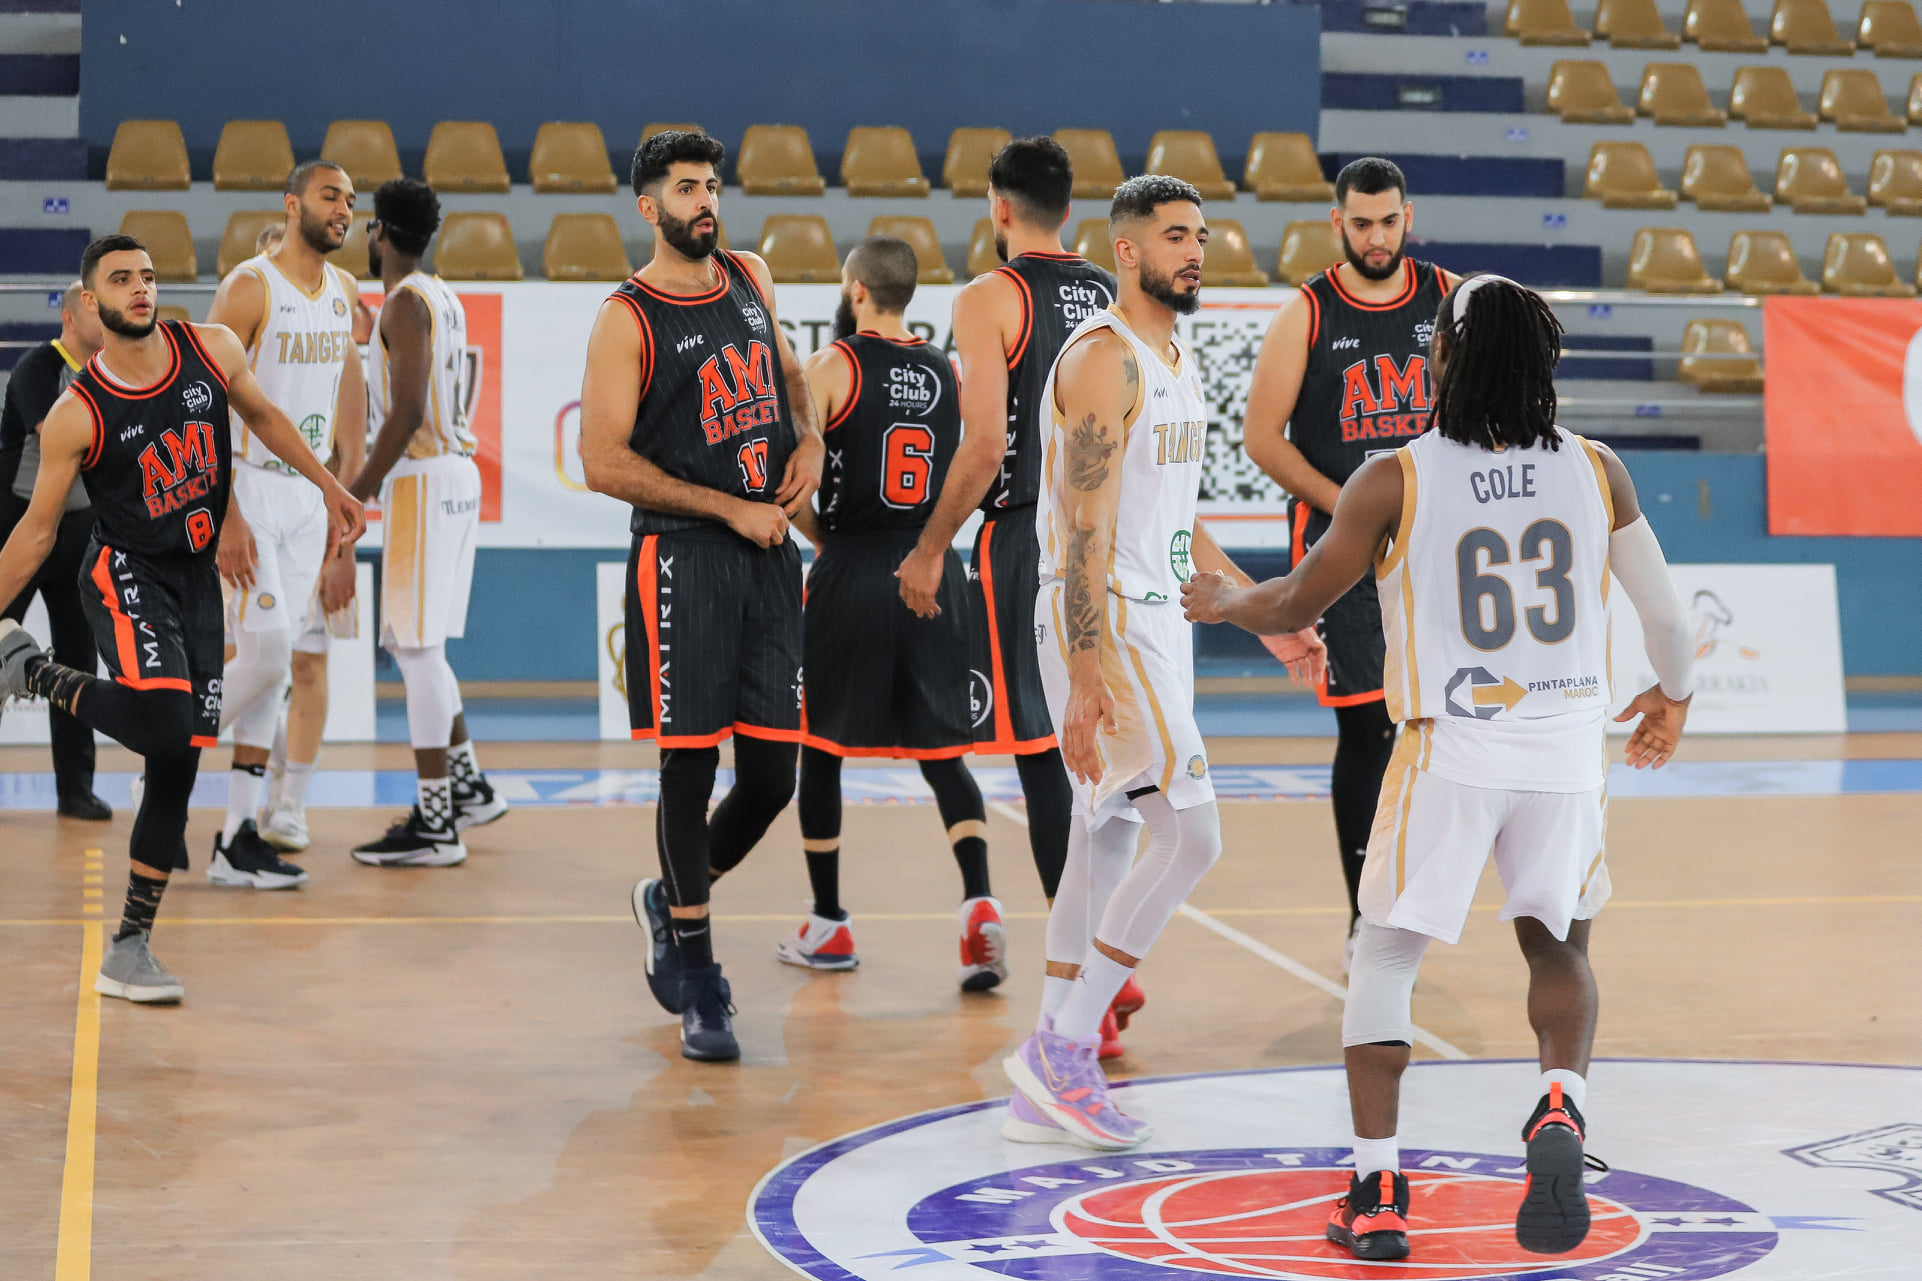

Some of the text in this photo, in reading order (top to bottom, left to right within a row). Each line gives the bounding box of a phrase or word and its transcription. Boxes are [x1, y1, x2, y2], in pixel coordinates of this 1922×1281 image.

[1059, 285, 1097, 305] City
[742, 306, 758, 318] City
[748, 316, 763, 327] Club
[697, 339, 776, 423] AMI
[889, 366, 926, 387] City
[182, 385, 203, 401] City
[186, 394, 209, 409] Club
[889, 384, 931, 402] Club
[889, 400, 928, 410] 24 HOURS
[1341, 411, 1438, 443] BASKE
[138, 421, 218, 502] AMI
[880, 422, 935, 510] 6
[145, 465, 219, 520] BASKT
[1470, 463, 1537, 504] COLE
[185, 507, 216, 554] 8
[1455, 517, 1576, 653] 63
[1528, 675, 1598, 693] PINTAPLANA
[1564, 686, 1599, 700] MAROC
[955, 1159, 1196, 1205] MAJD
